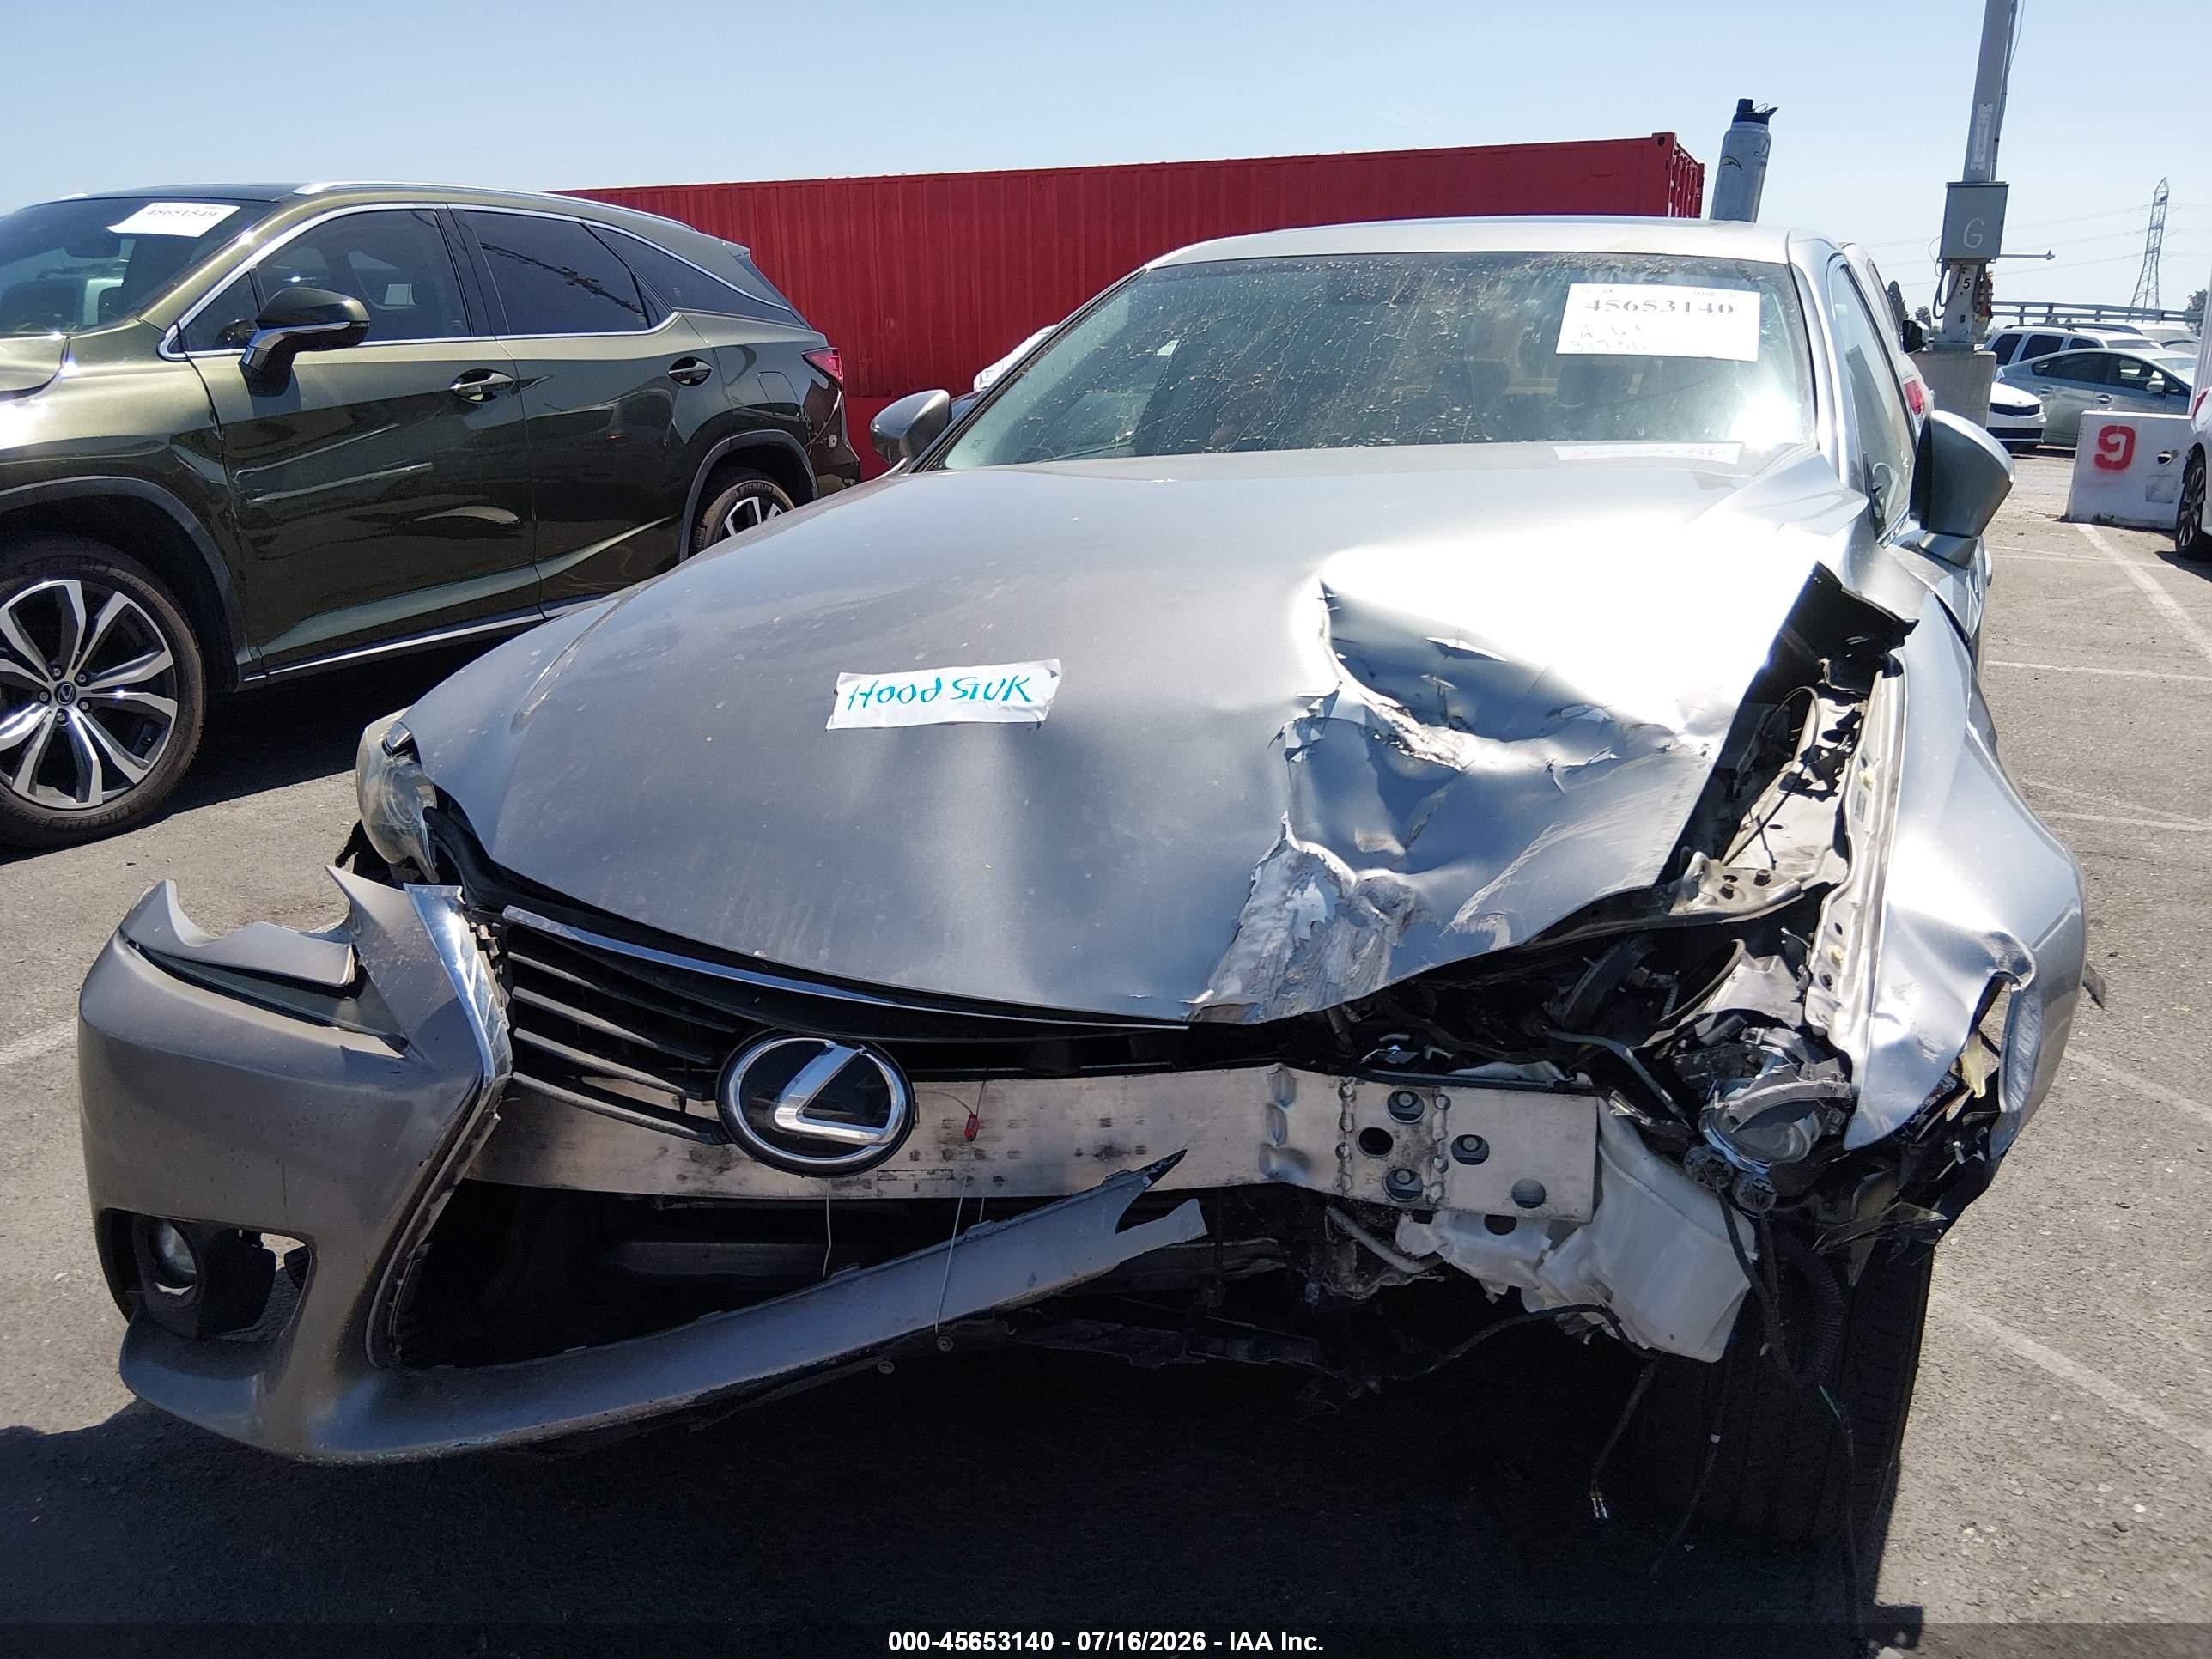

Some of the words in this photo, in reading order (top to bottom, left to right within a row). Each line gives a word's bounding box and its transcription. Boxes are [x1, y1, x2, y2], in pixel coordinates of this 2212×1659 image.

[1963, 218, 1985, 249] G
[1962, 277, 1972, 289] 5
[1584, 298, 1735, 314] 45653140
[2094, 425, 2136, 471] 9
